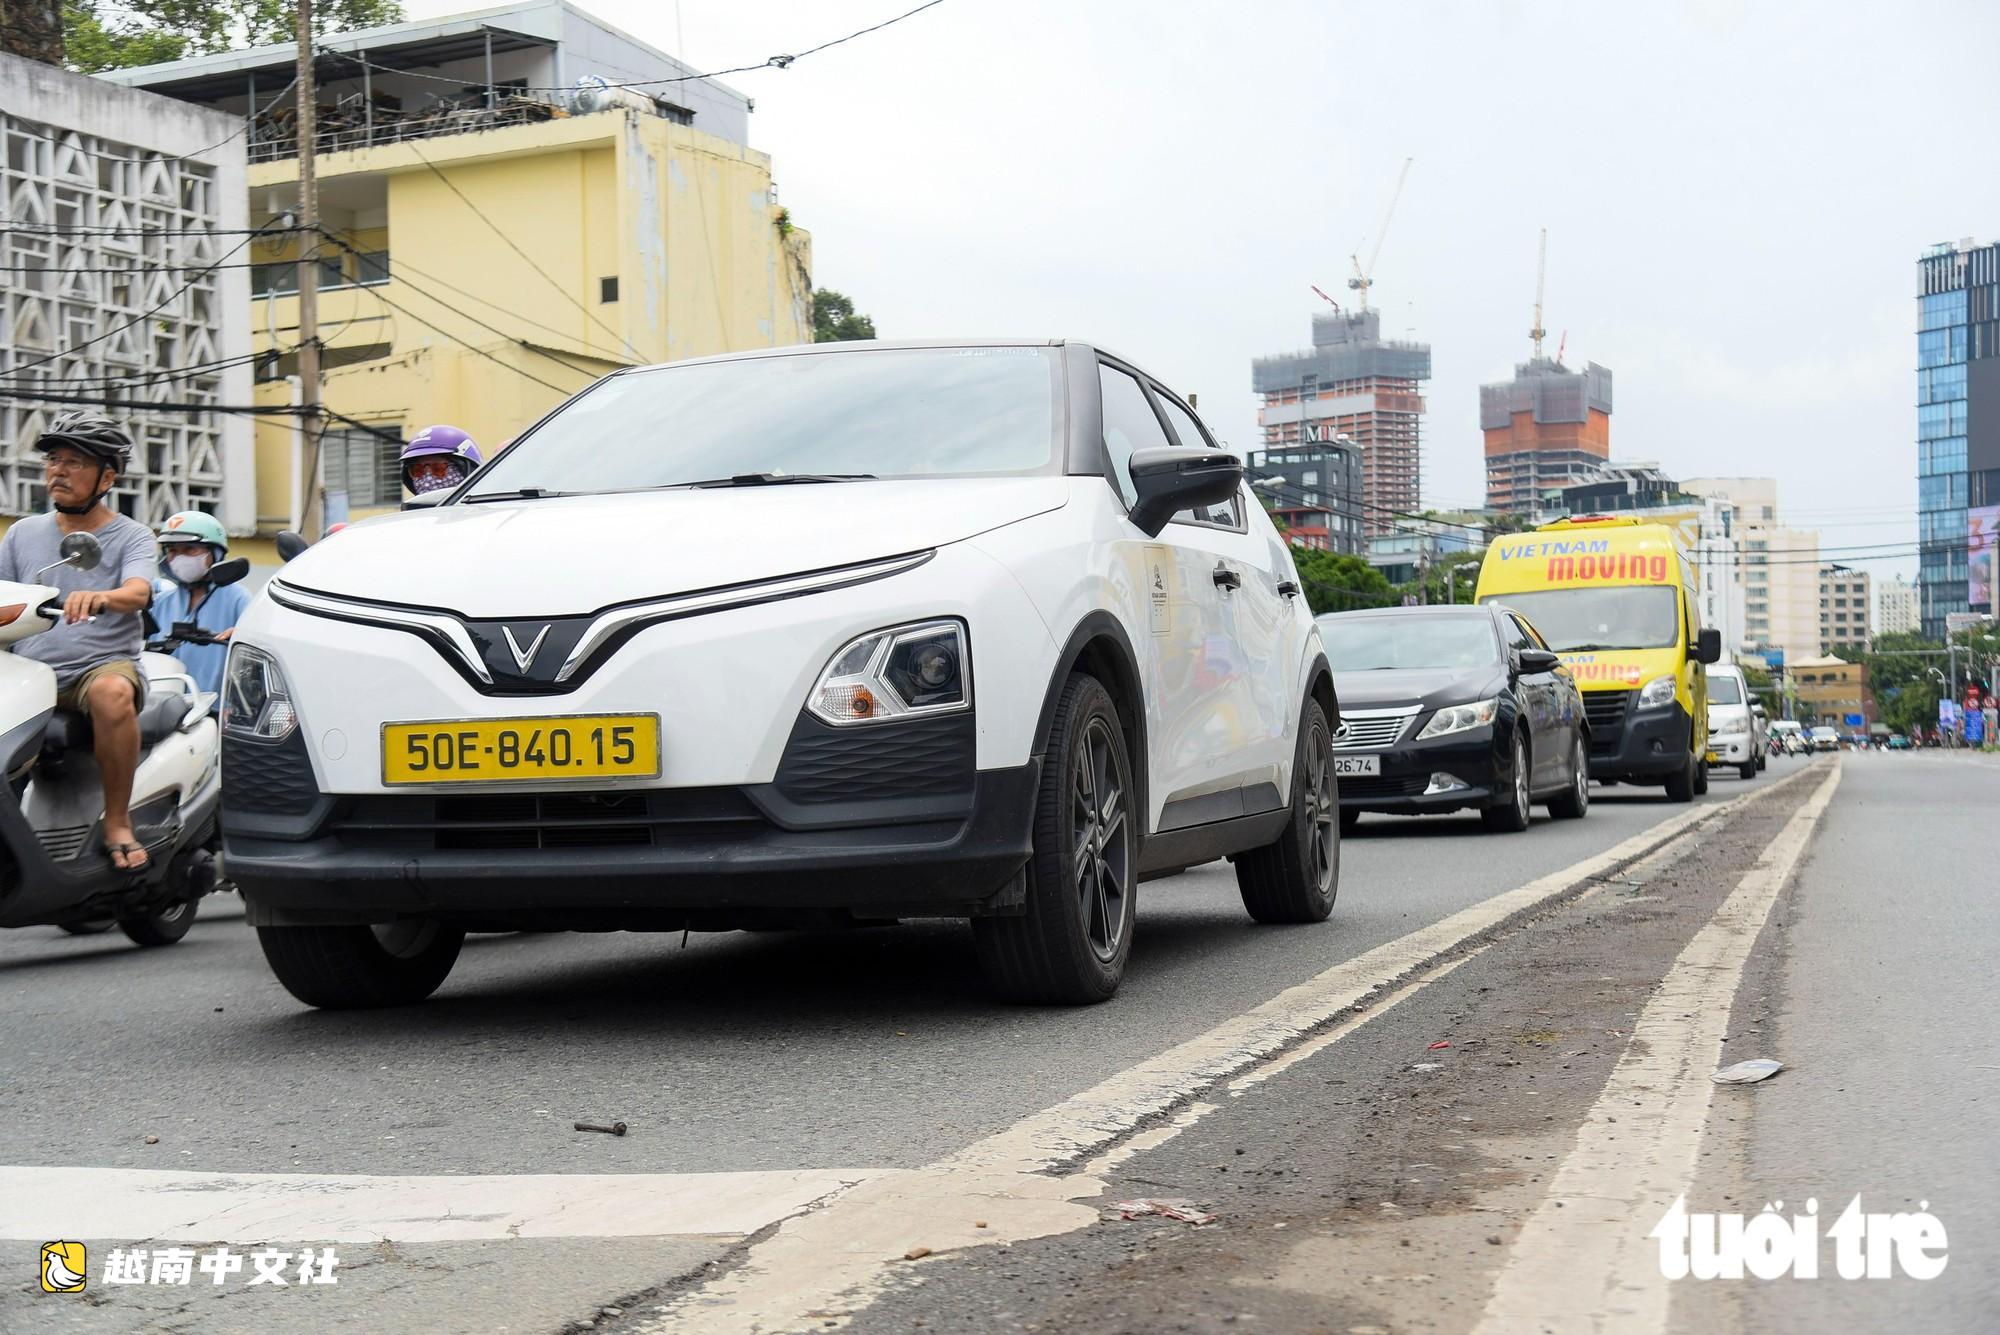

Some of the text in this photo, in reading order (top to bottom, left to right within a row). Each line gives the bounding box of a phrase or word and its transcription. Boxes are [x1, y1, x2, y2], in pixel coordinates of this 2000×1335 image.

[1500, 540, 1608, 561] VIETNAM
[1547, 553, 1667, 582] moving
[1569, 664, 1641, 685] oving
[407, 726, 635, 771] 50E-840.15
